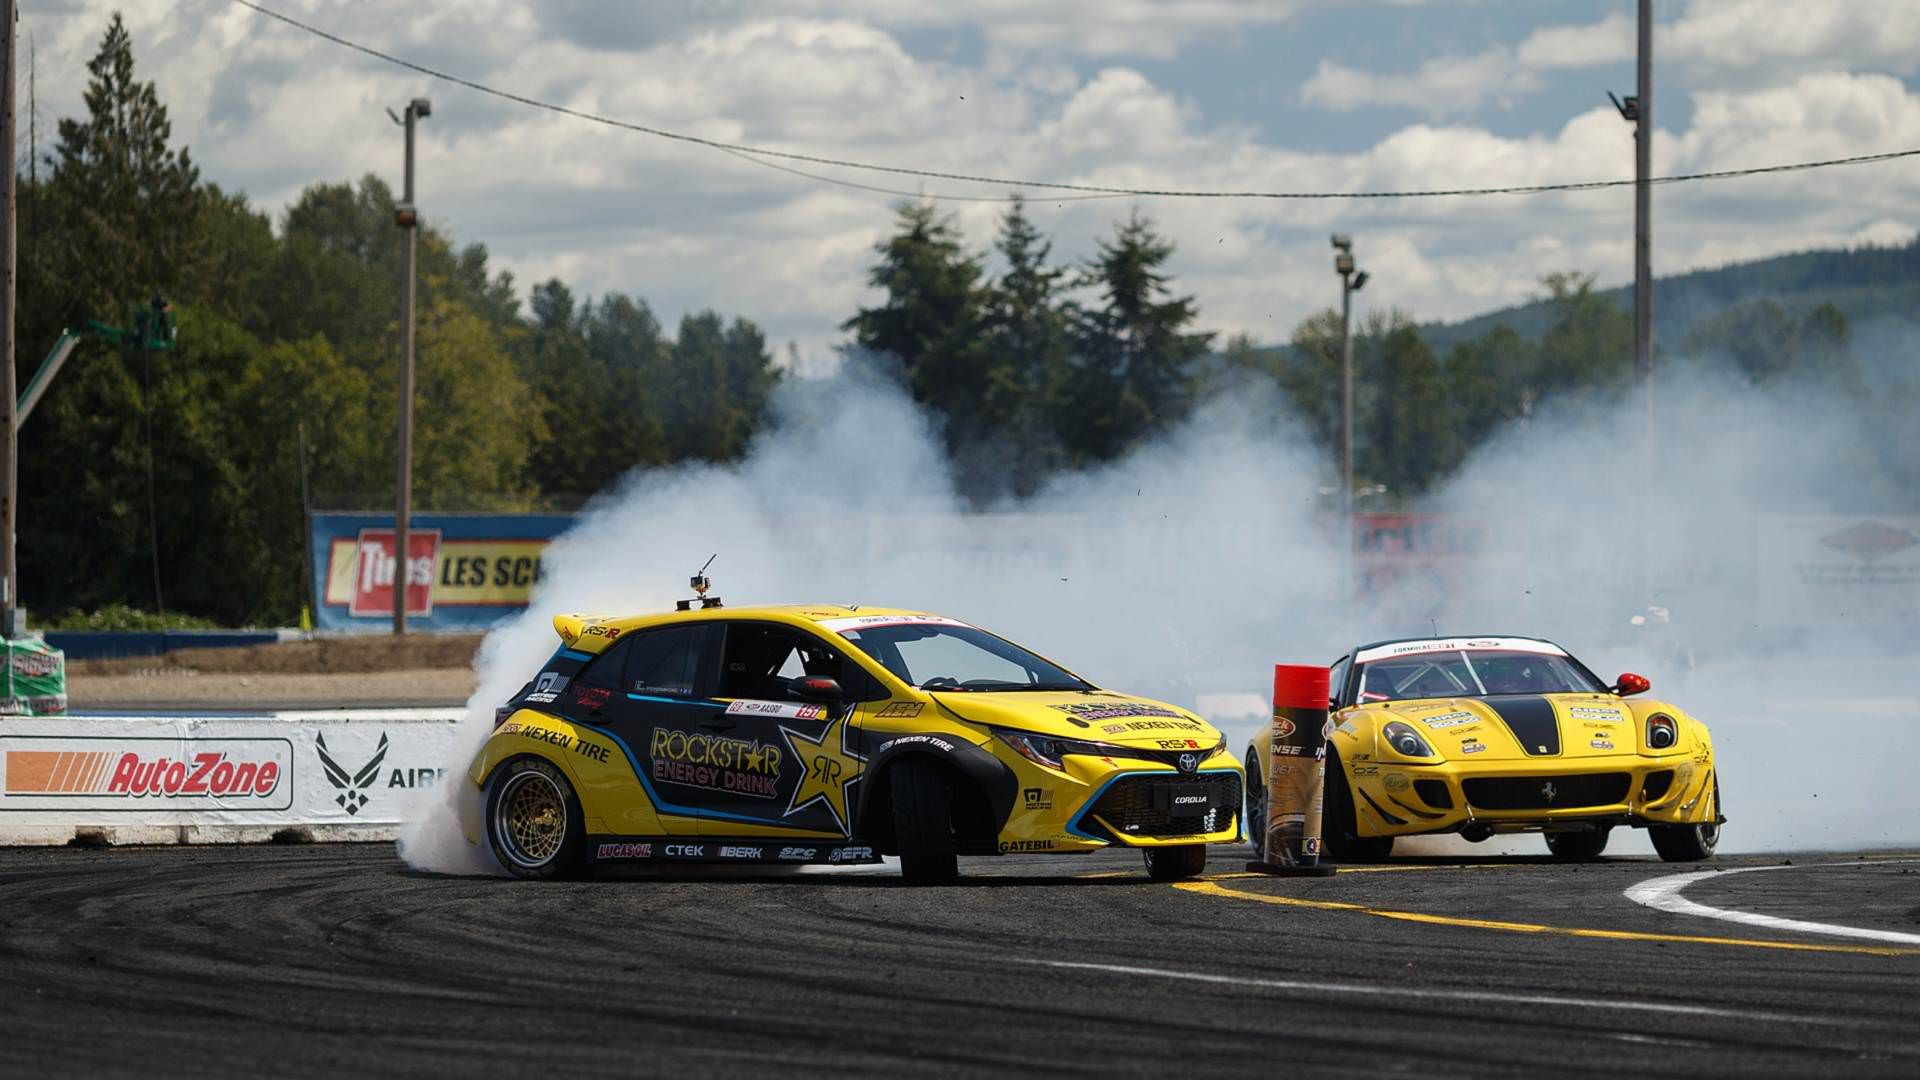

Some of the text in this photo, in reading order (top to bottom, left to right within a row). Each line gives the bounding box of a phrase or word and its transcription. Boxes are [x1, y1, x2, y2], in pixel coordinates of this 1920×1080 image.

[441, 556, 486, 586] LES
[798, 706, 819, 718] 151
[521, 725, 574, 748] NEXEN
[574, 739, 611, 763] TIRE
[894, 736, 930, 746] NEXEN
[929, 737, 955, 752] TIRE
[108, 752, 282, 795] AutoZone
[1353, 767, 1380, 775] OZ
[654, 760, 776, 797] ENERGY DRINK
[1174, 796, 1208, 804] COROLLA
[598, 843, 652, 858] LUCAS OIL
[664, 844, 704, 856] CTEK
[727, 846, 762, 858] BERK
[999, 840, 1055, 852] GATEBIL
